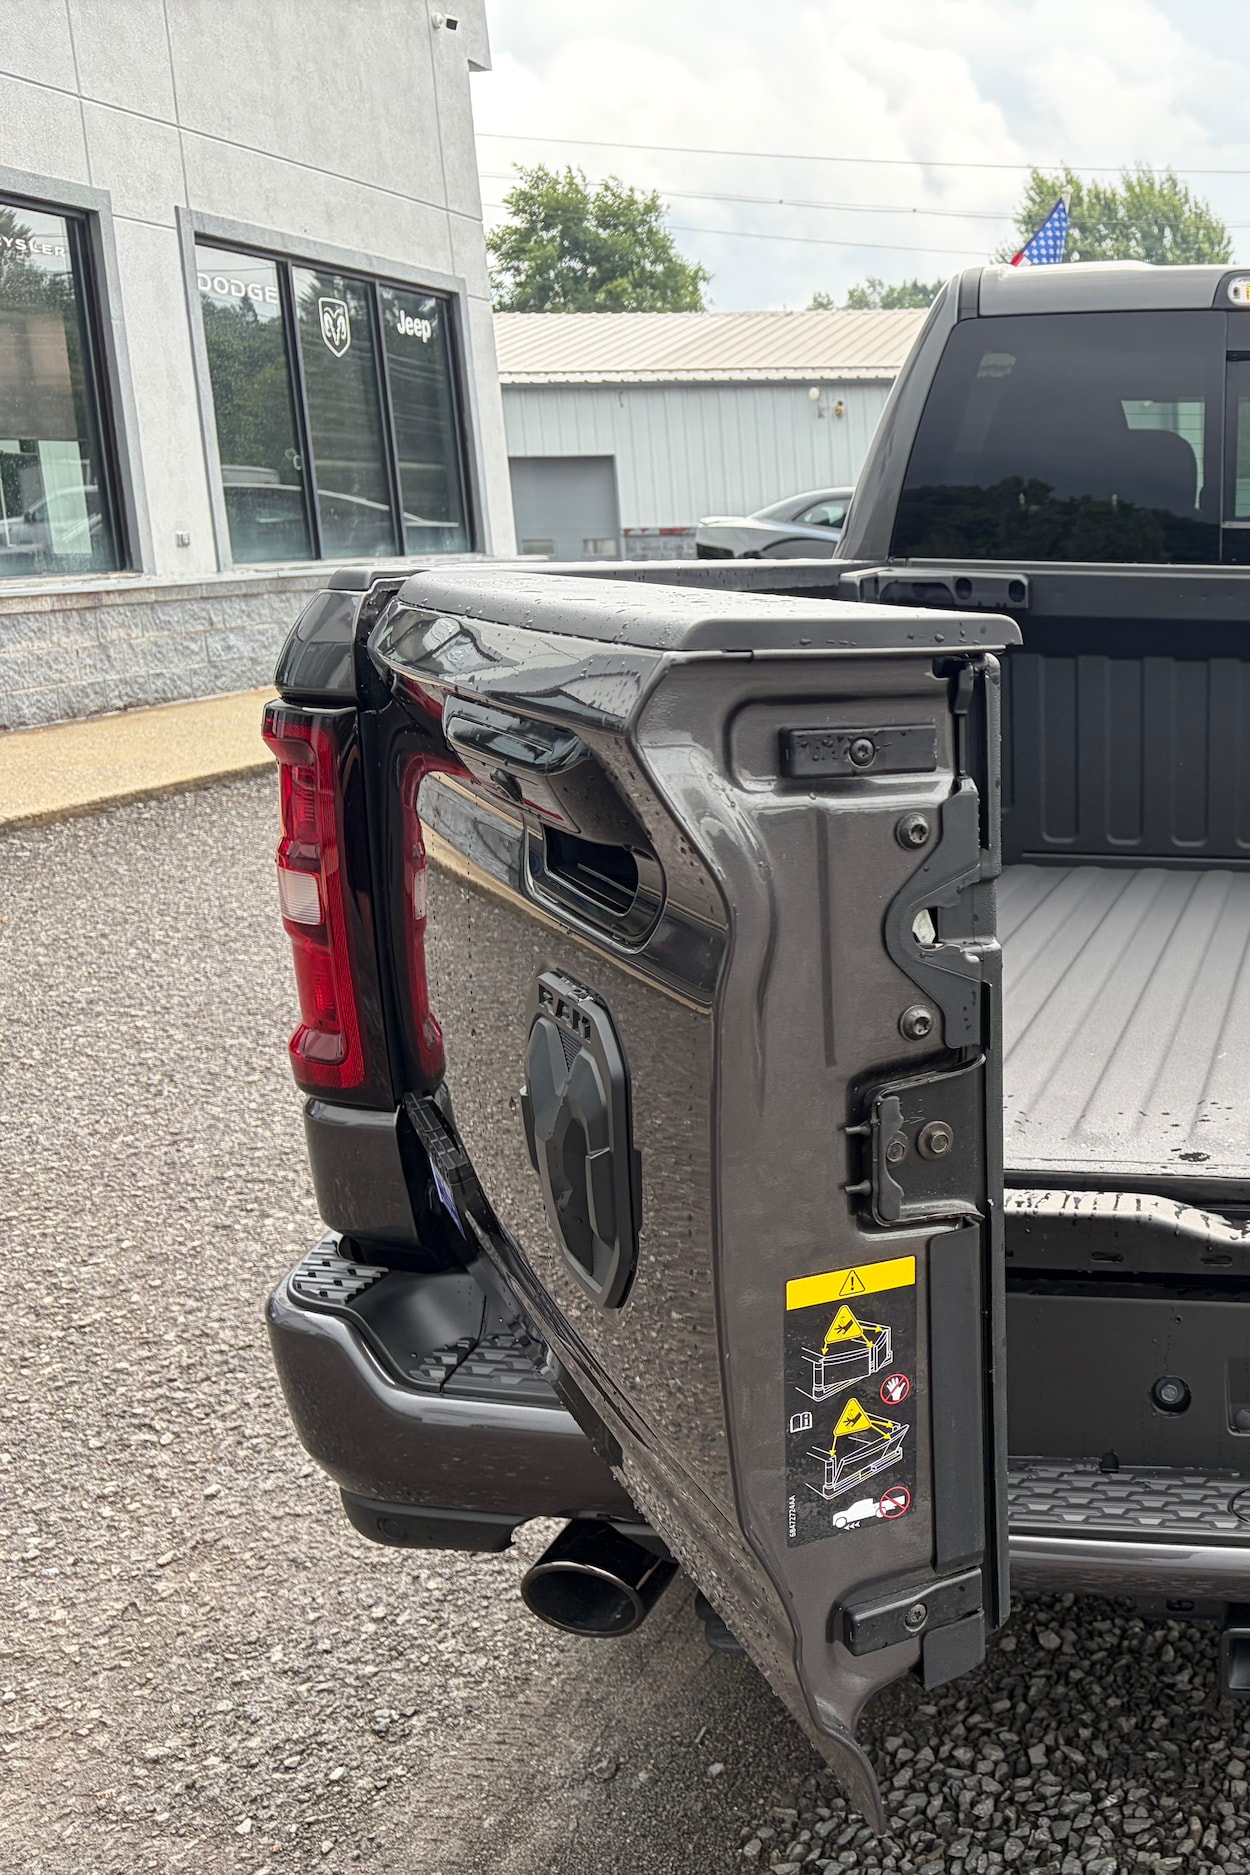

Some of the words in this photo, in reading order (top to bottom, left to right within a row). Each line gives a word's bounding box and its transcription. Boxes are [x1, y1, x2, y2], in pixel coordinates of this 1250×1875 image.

[0, 235, 66, 258] YSLER
[196, 271, 279, 305] DODGE
[396, 309, 432, 344] Jeep
